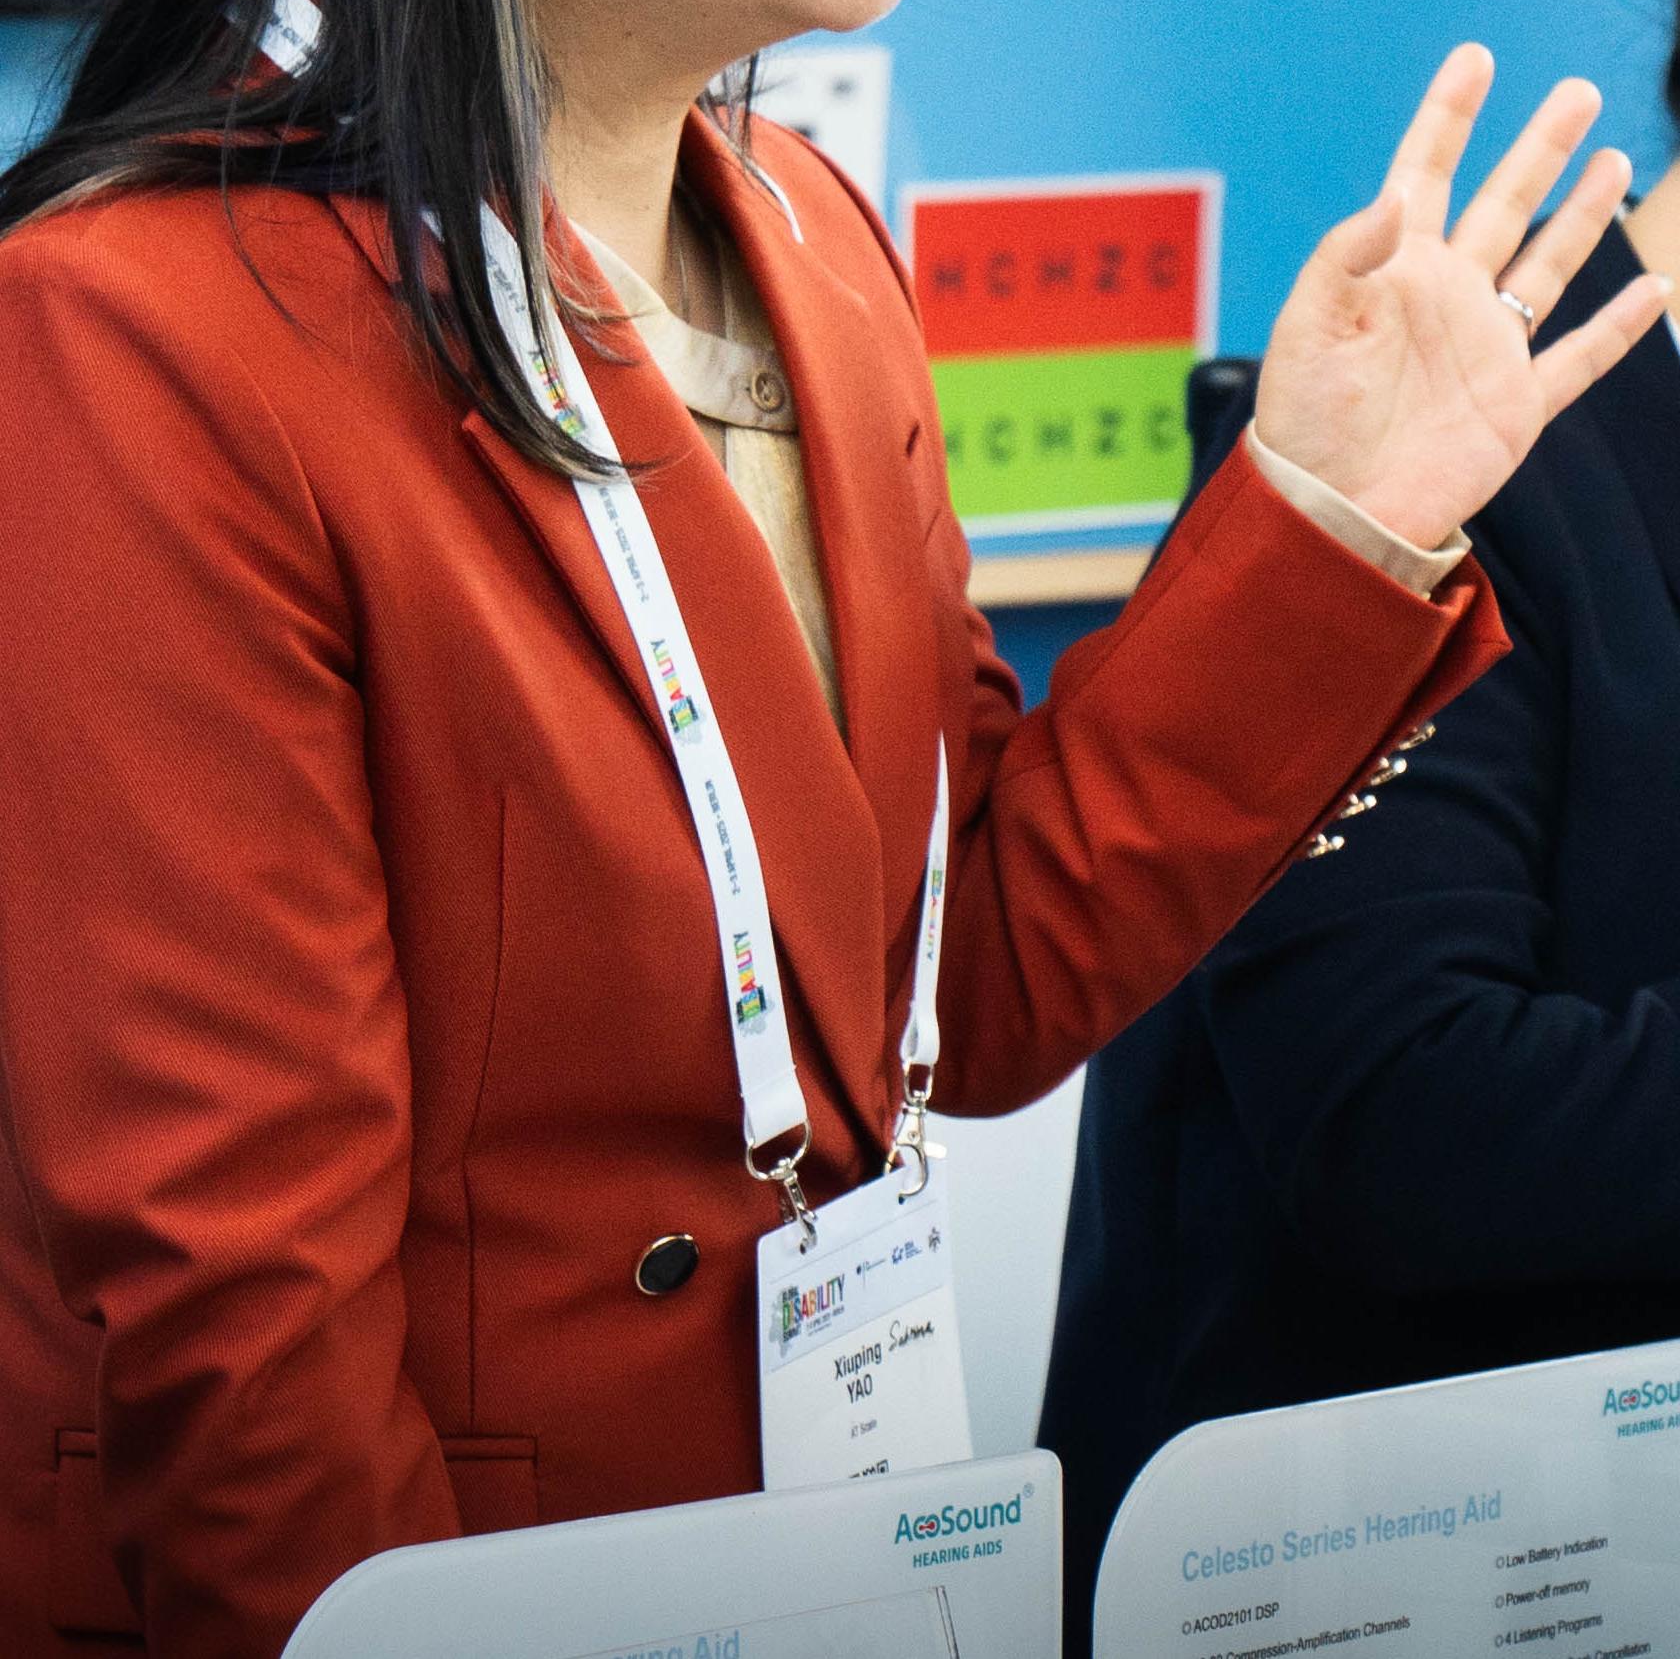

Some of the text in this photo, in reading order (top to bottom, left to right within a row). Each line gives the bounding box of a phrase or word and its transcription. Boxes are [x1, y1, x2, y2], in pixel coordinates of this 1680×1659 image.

[782, 1273, 846, 1331] DISABILITY
[834, 1343, 882, 1382] Xiuping
[846, 1373, 873, 1404] YAO
[1616, 1417, 1665, 1439] HEARING
[893, 1493, 1023, 1545] AcoSound
[1180, 1489, 1502, 1583] Celesto Series Hearing Aid
[1505, 1536, 1609, 1569] Low Battery Indication
[912, 1539, 1004, 1569] HEARING AIDS
[1505, 1578, 1592, 1608] Power-off memory
[1193, 1601, 1281, 1635] ACOD2101 DSP
[1363, 1615, 1411, 1638] Channels
[1504, 1614, 1604, 1647] 4 Listening Programs
[695, 1629, 740, 1659] Aid
